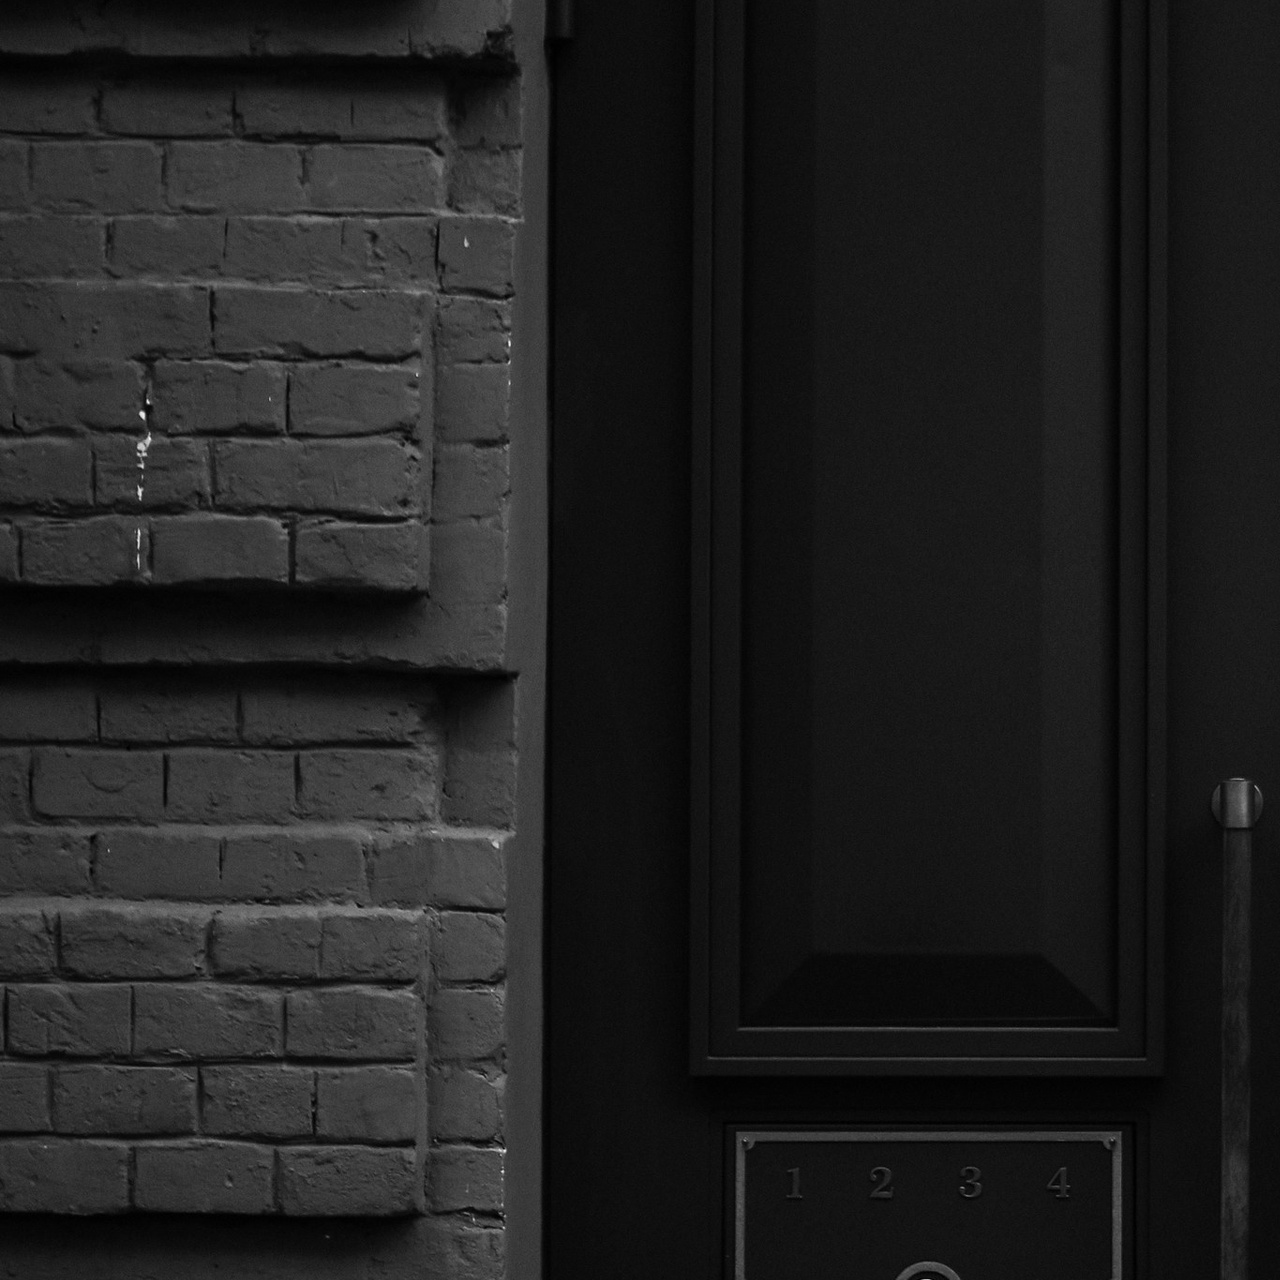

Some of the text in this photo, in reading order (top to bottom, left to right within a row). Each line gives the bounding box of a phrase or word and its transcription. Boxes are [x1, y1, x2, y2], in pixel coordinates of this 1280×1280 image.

[785, 1165, 1072, 1200] 1 2 3 4
